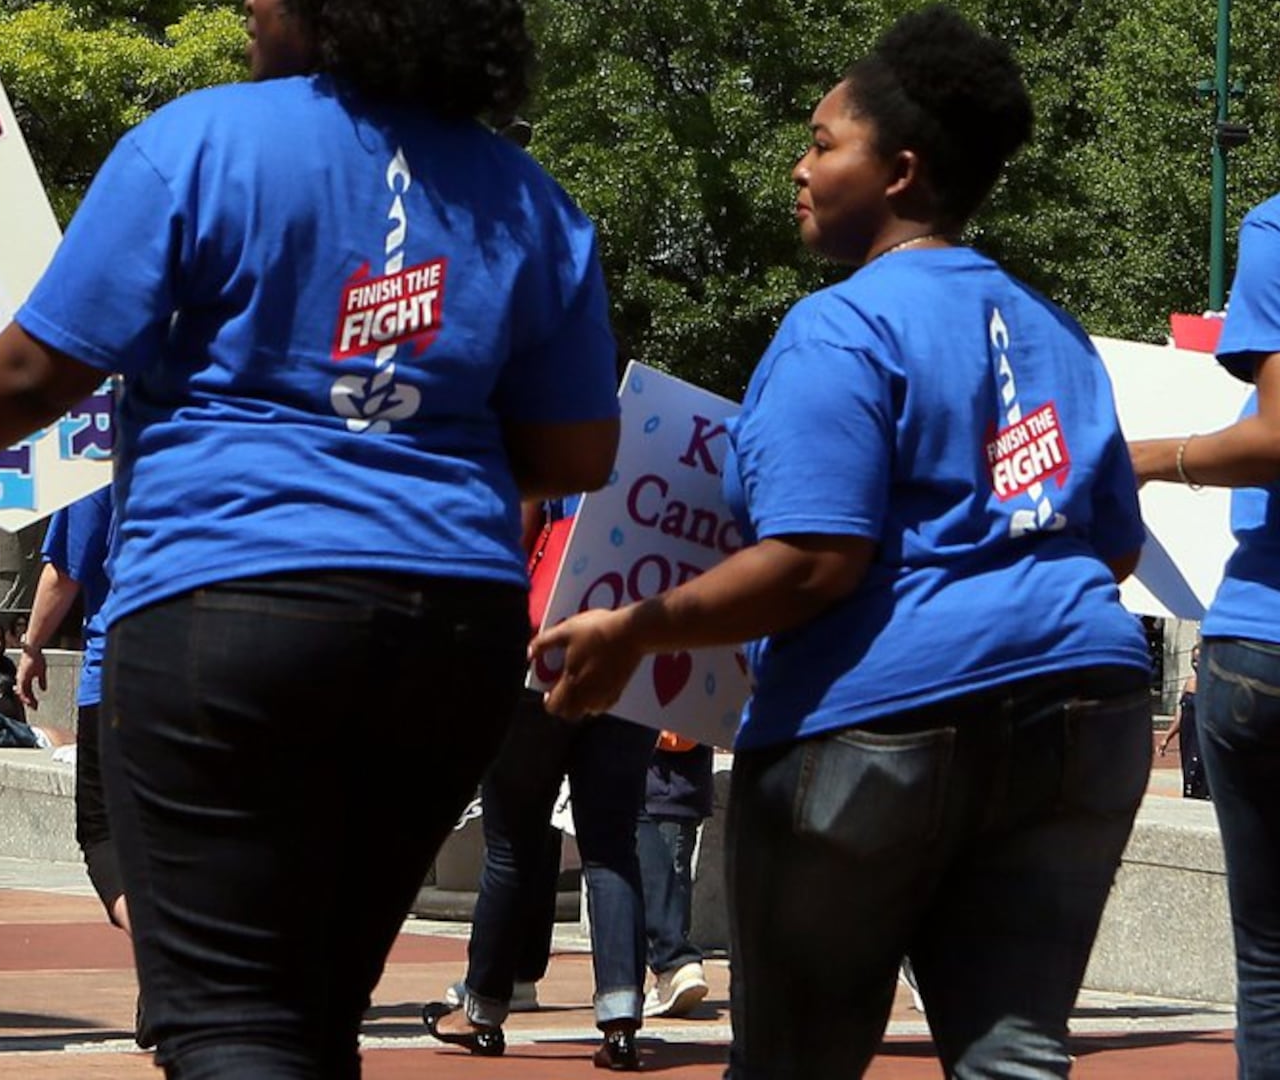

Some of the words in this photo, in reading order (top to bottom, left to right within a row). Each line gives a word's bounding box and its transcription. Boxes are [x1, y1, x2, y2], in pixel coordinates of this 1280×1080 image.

[347, 274, 403, 311] FINISH
[405, 263, 441, 293] THE
[340, 289, 438, 352] FIGHT
[987, 423, 1031, 462] FINISH
[1026, 406, 1057, 437] THE
[993, 428, 1062, 497] FIGHT
[626, 474, 747, 555] Canc
